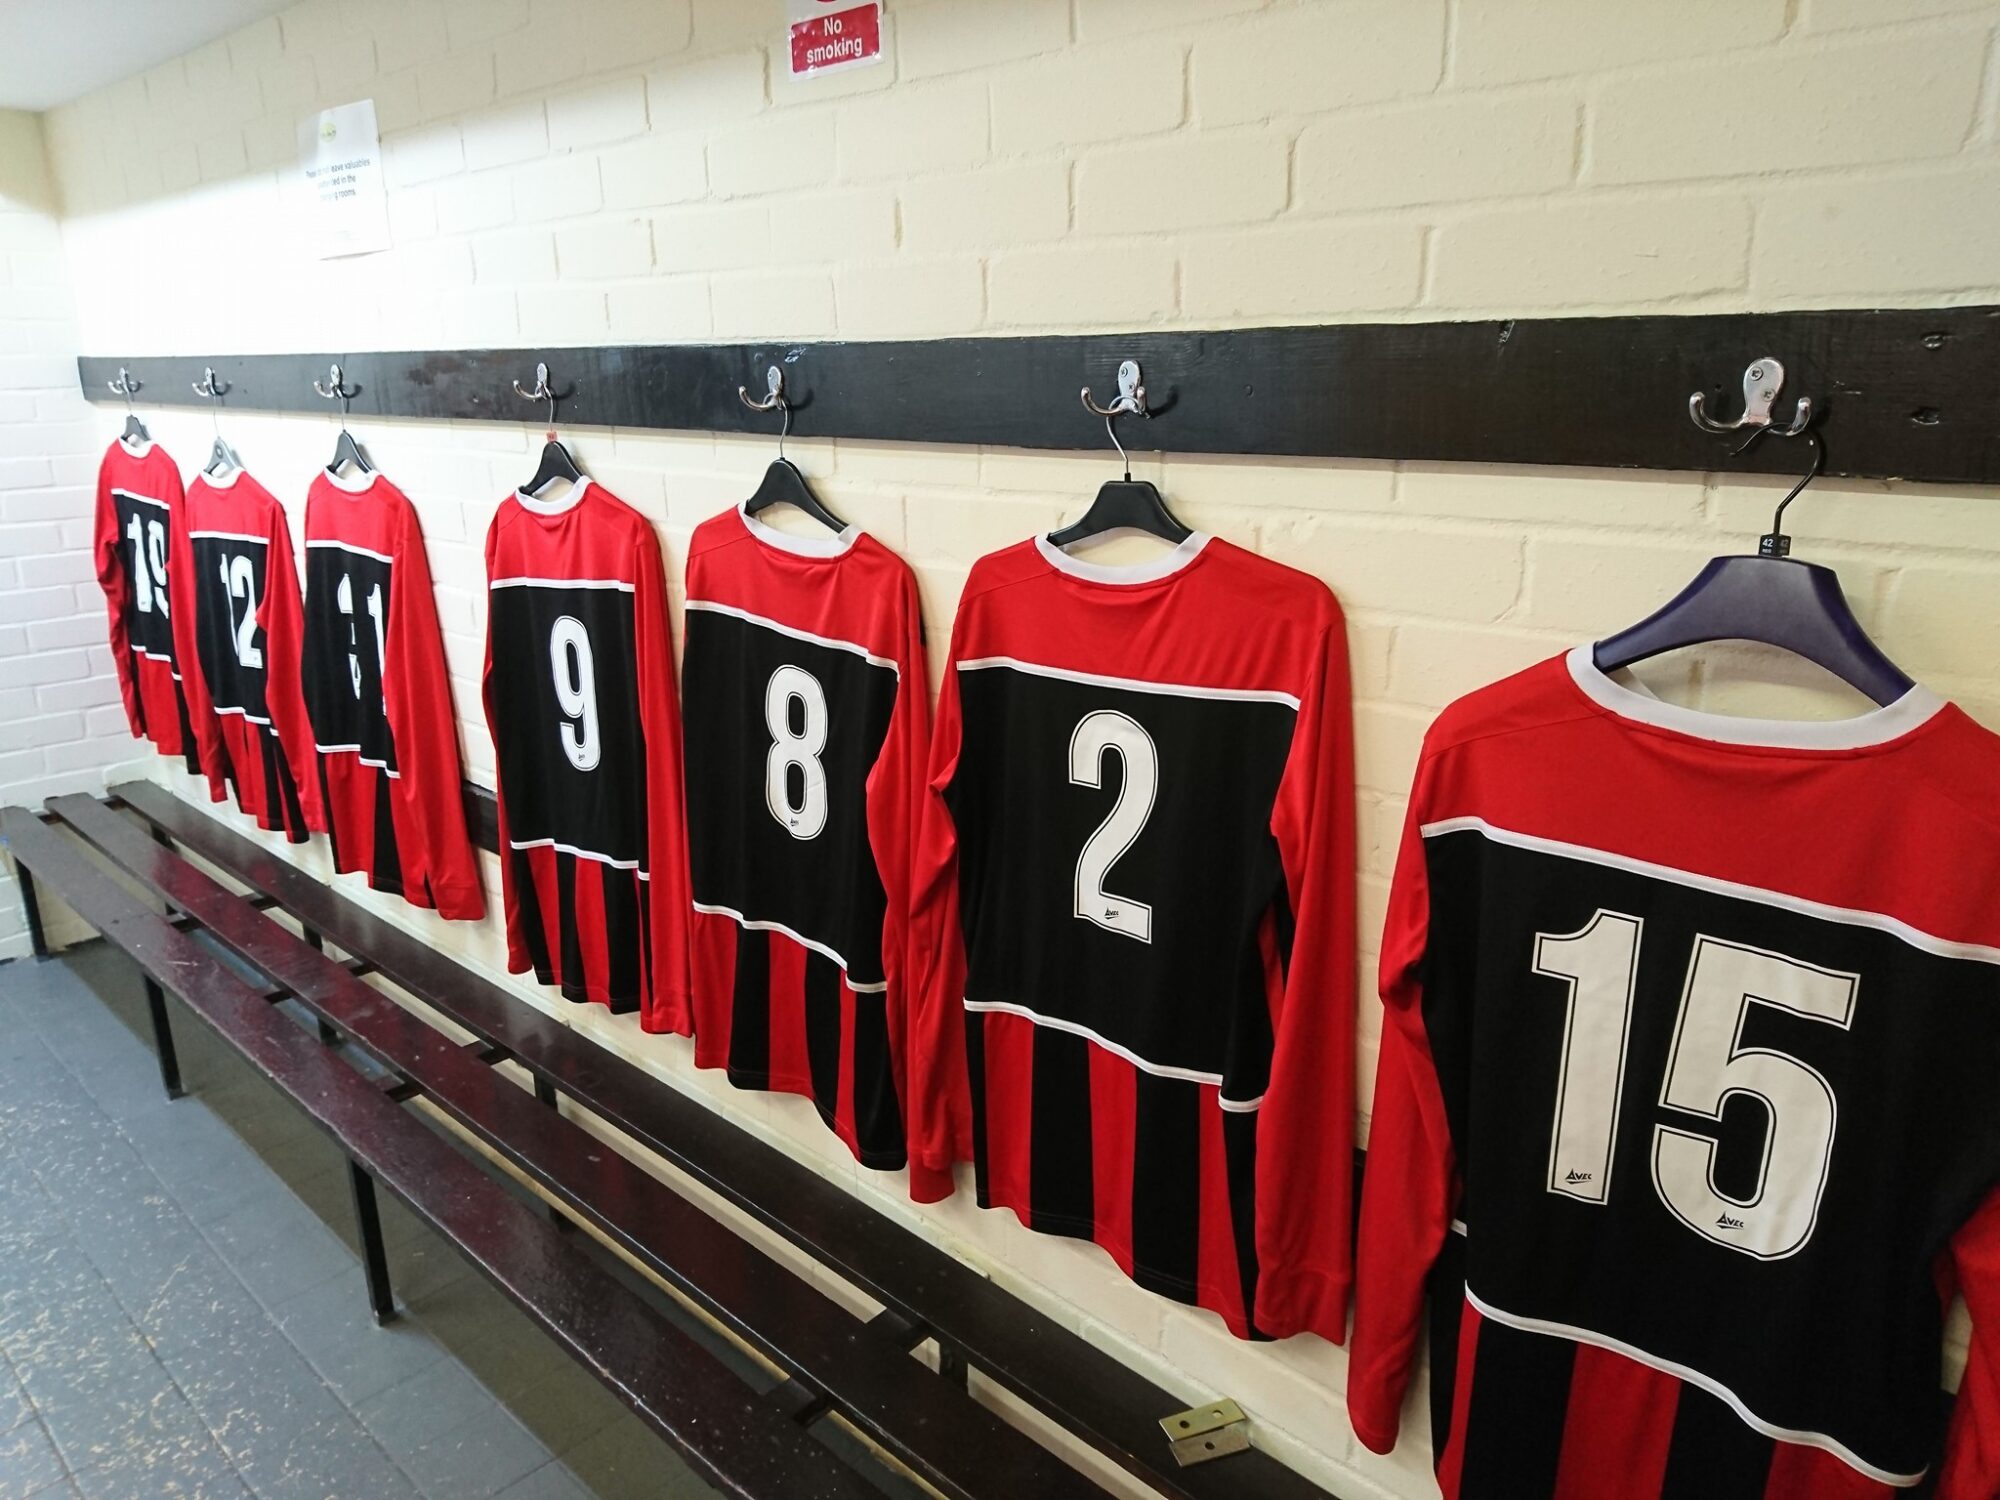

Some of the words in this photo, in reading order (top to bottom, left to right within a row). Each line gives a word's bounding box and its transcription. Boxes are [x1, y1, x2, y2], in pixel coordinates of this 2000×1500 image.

[806, 37, 863, 63] smoking
[823, 17, 843, 36] No
[127, 513, 170, 619] 19
[1762, 538, 1774, 548] 42
[220, 553, 263, 669] 12
[550, 615, 601, 772] 9
[765, 664, 828, 840] 8
[1069, 709, 1158, 944] 2
[1531, 908, 1861, 1261] 15
